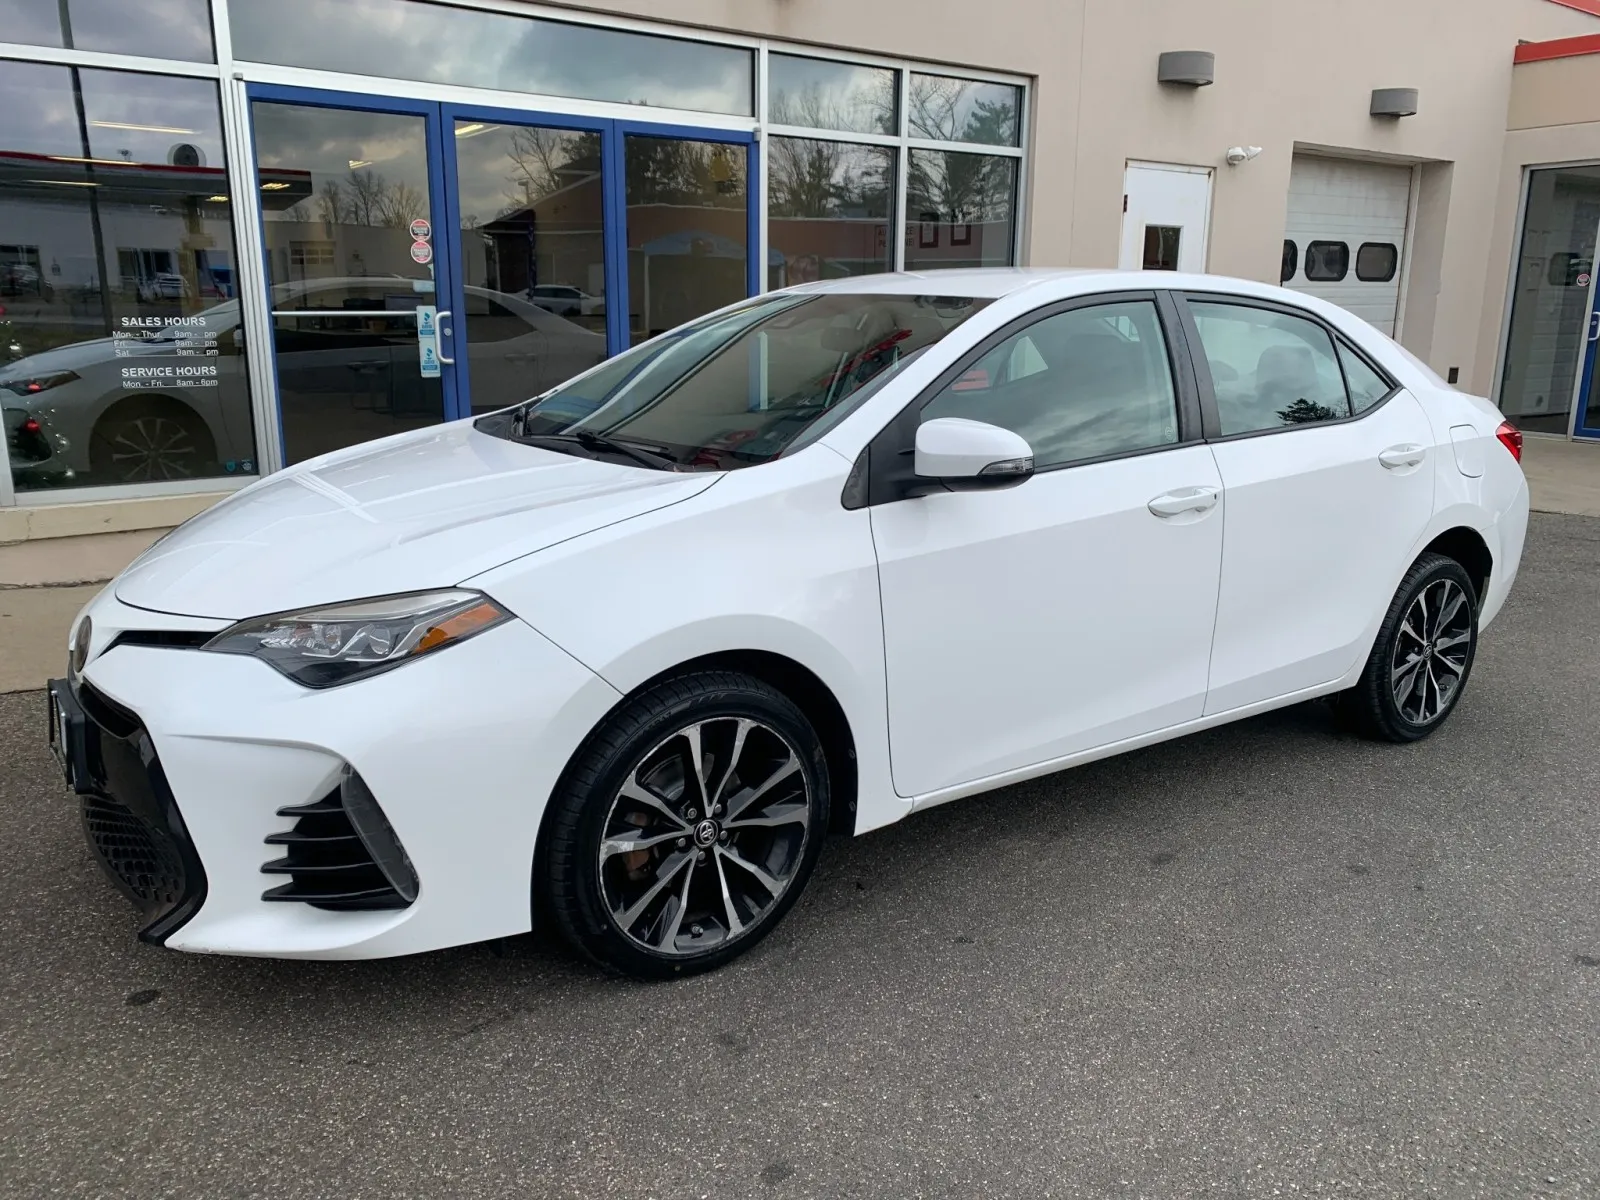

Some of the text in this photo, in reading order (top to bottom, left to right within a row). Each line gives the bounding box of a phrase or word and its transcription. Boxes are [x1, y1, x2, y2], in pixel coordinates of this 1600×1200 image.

[121, 317, 206, 326] SALES HOURS
[121, 366, 217, 377] SERVICE HOURS
